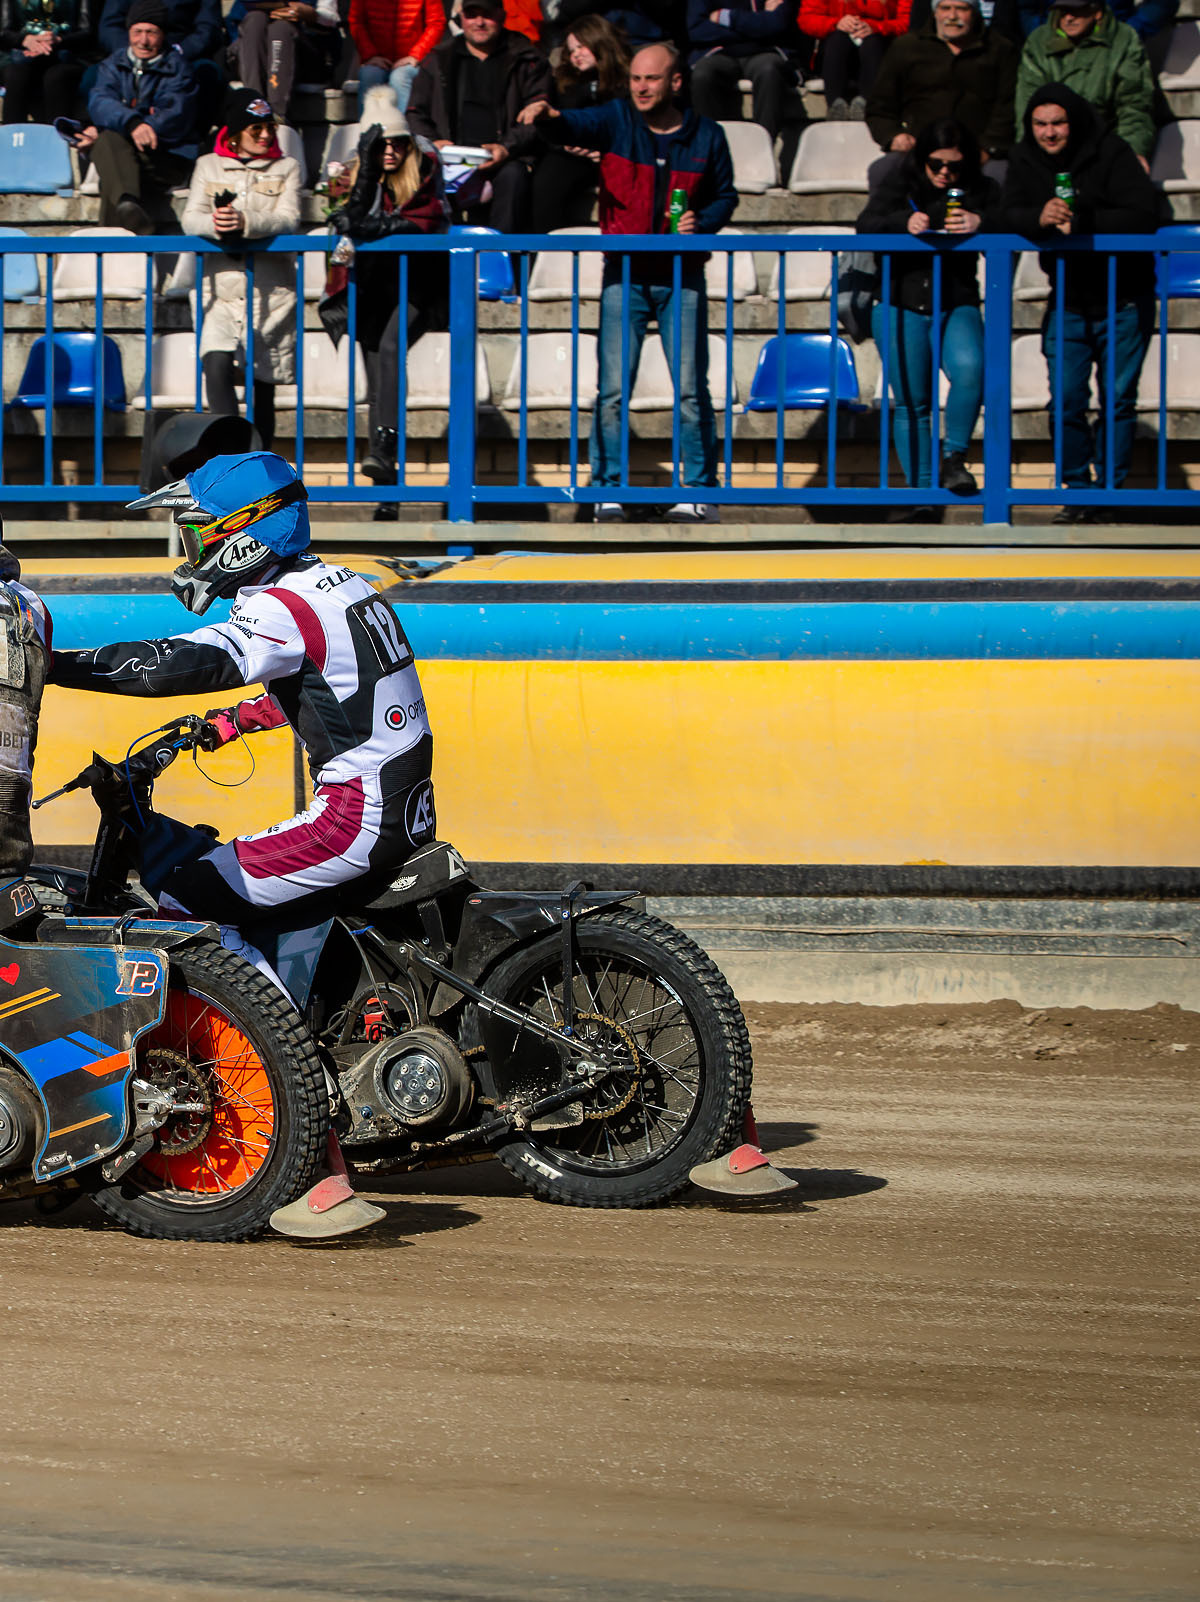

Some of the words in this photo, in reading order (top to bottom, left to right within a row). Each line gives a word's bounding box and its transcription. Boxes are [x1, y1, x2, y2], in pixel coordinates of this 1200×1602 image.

[12, 131, 25, 147] 11
[315, 567, 357, 593] ELLIS
[363, 600, 410, 664] 12
[10, 883, 37, 917] 12
[114, 960, 160, 997] 12
